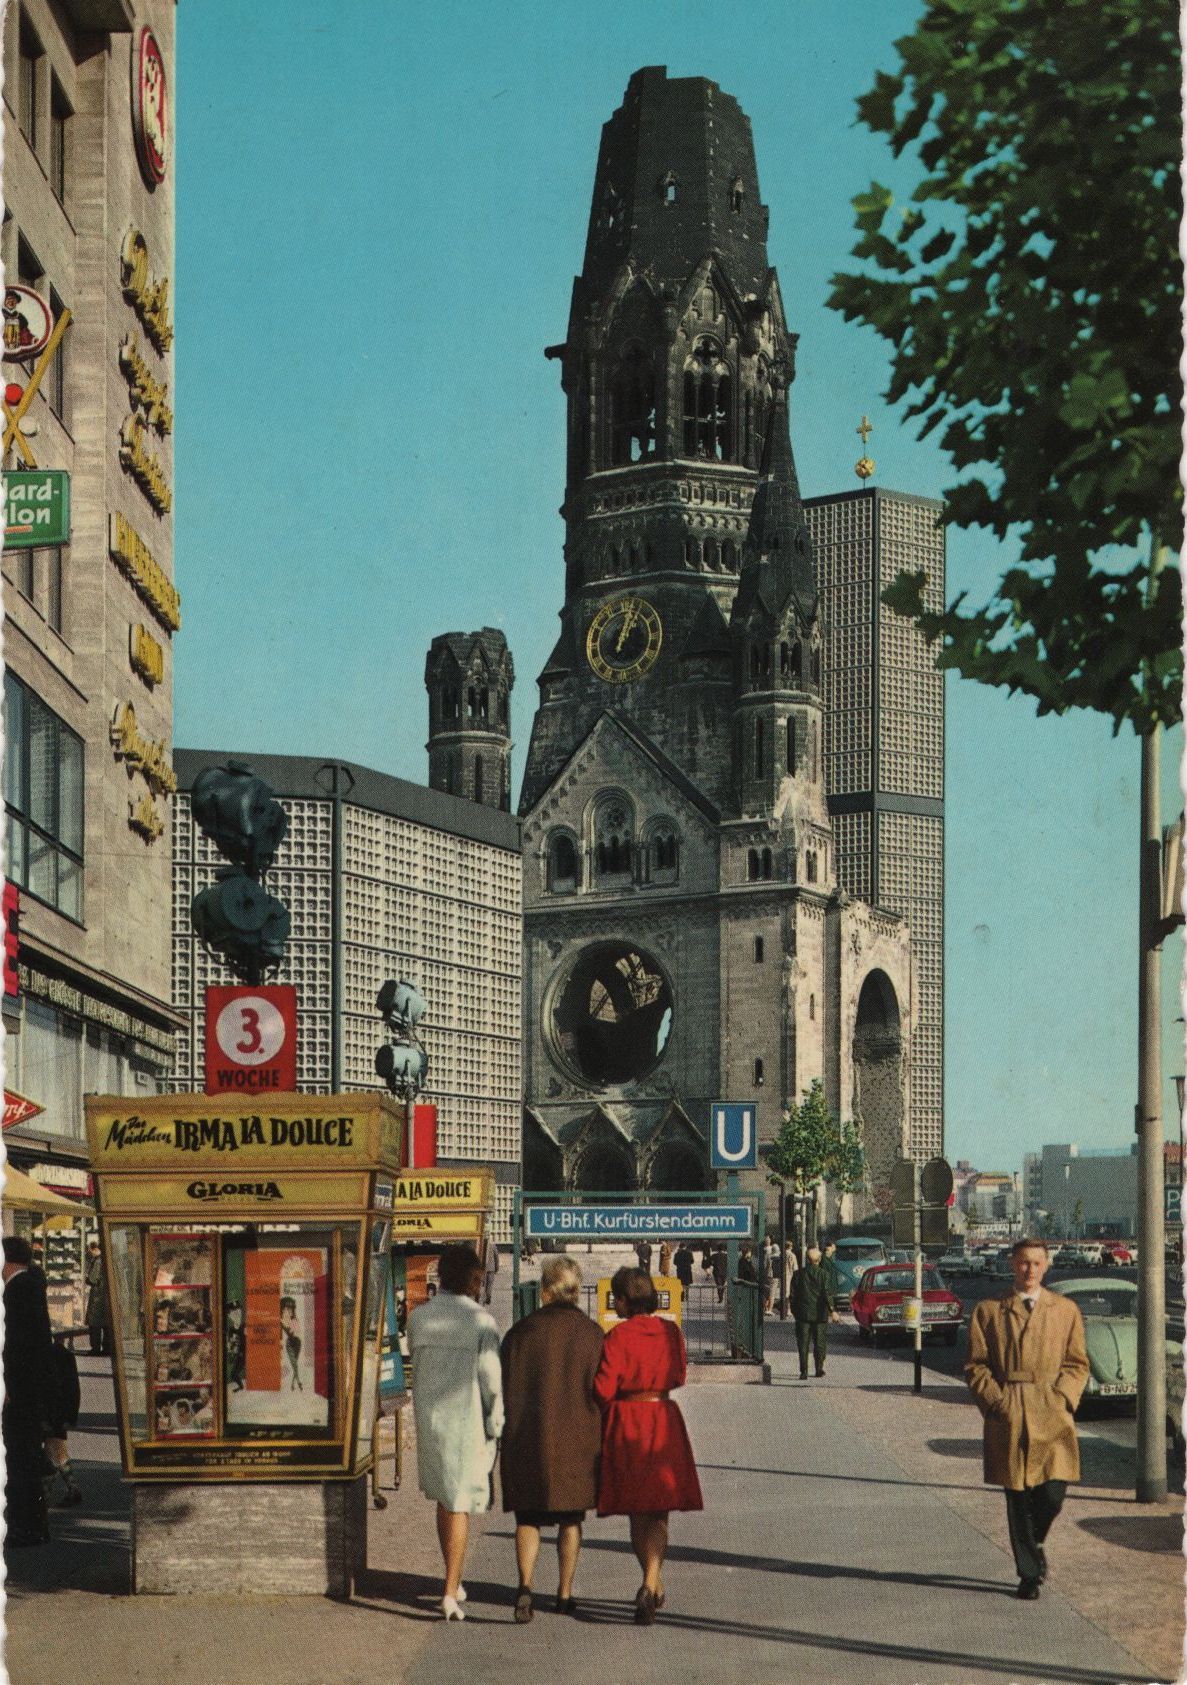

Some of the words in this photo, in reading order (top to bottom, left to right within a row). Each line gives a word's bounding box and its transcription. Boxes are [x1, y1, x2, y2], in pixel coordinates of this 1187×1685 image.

[236, 1008, 265, 1054] 3.
[217, 1070, 280, 1088] WOCHE
[174, 1119, 239, 1151] IRMA
[239, 1115, 266, 1145] LA
[269, 1117, 353, 1147] DOUCE
[717, 1110, 751, 1162] U
[187, 1181, 284, 1201] GLORIA
[409, 1181, 423, 1201] LA
[425, 1181, 471, 1199] DOUCE
[543, 1212, 590, 1229] U-Bhf.
[594, 1211, 736, 1229] Kurfürstendamm
